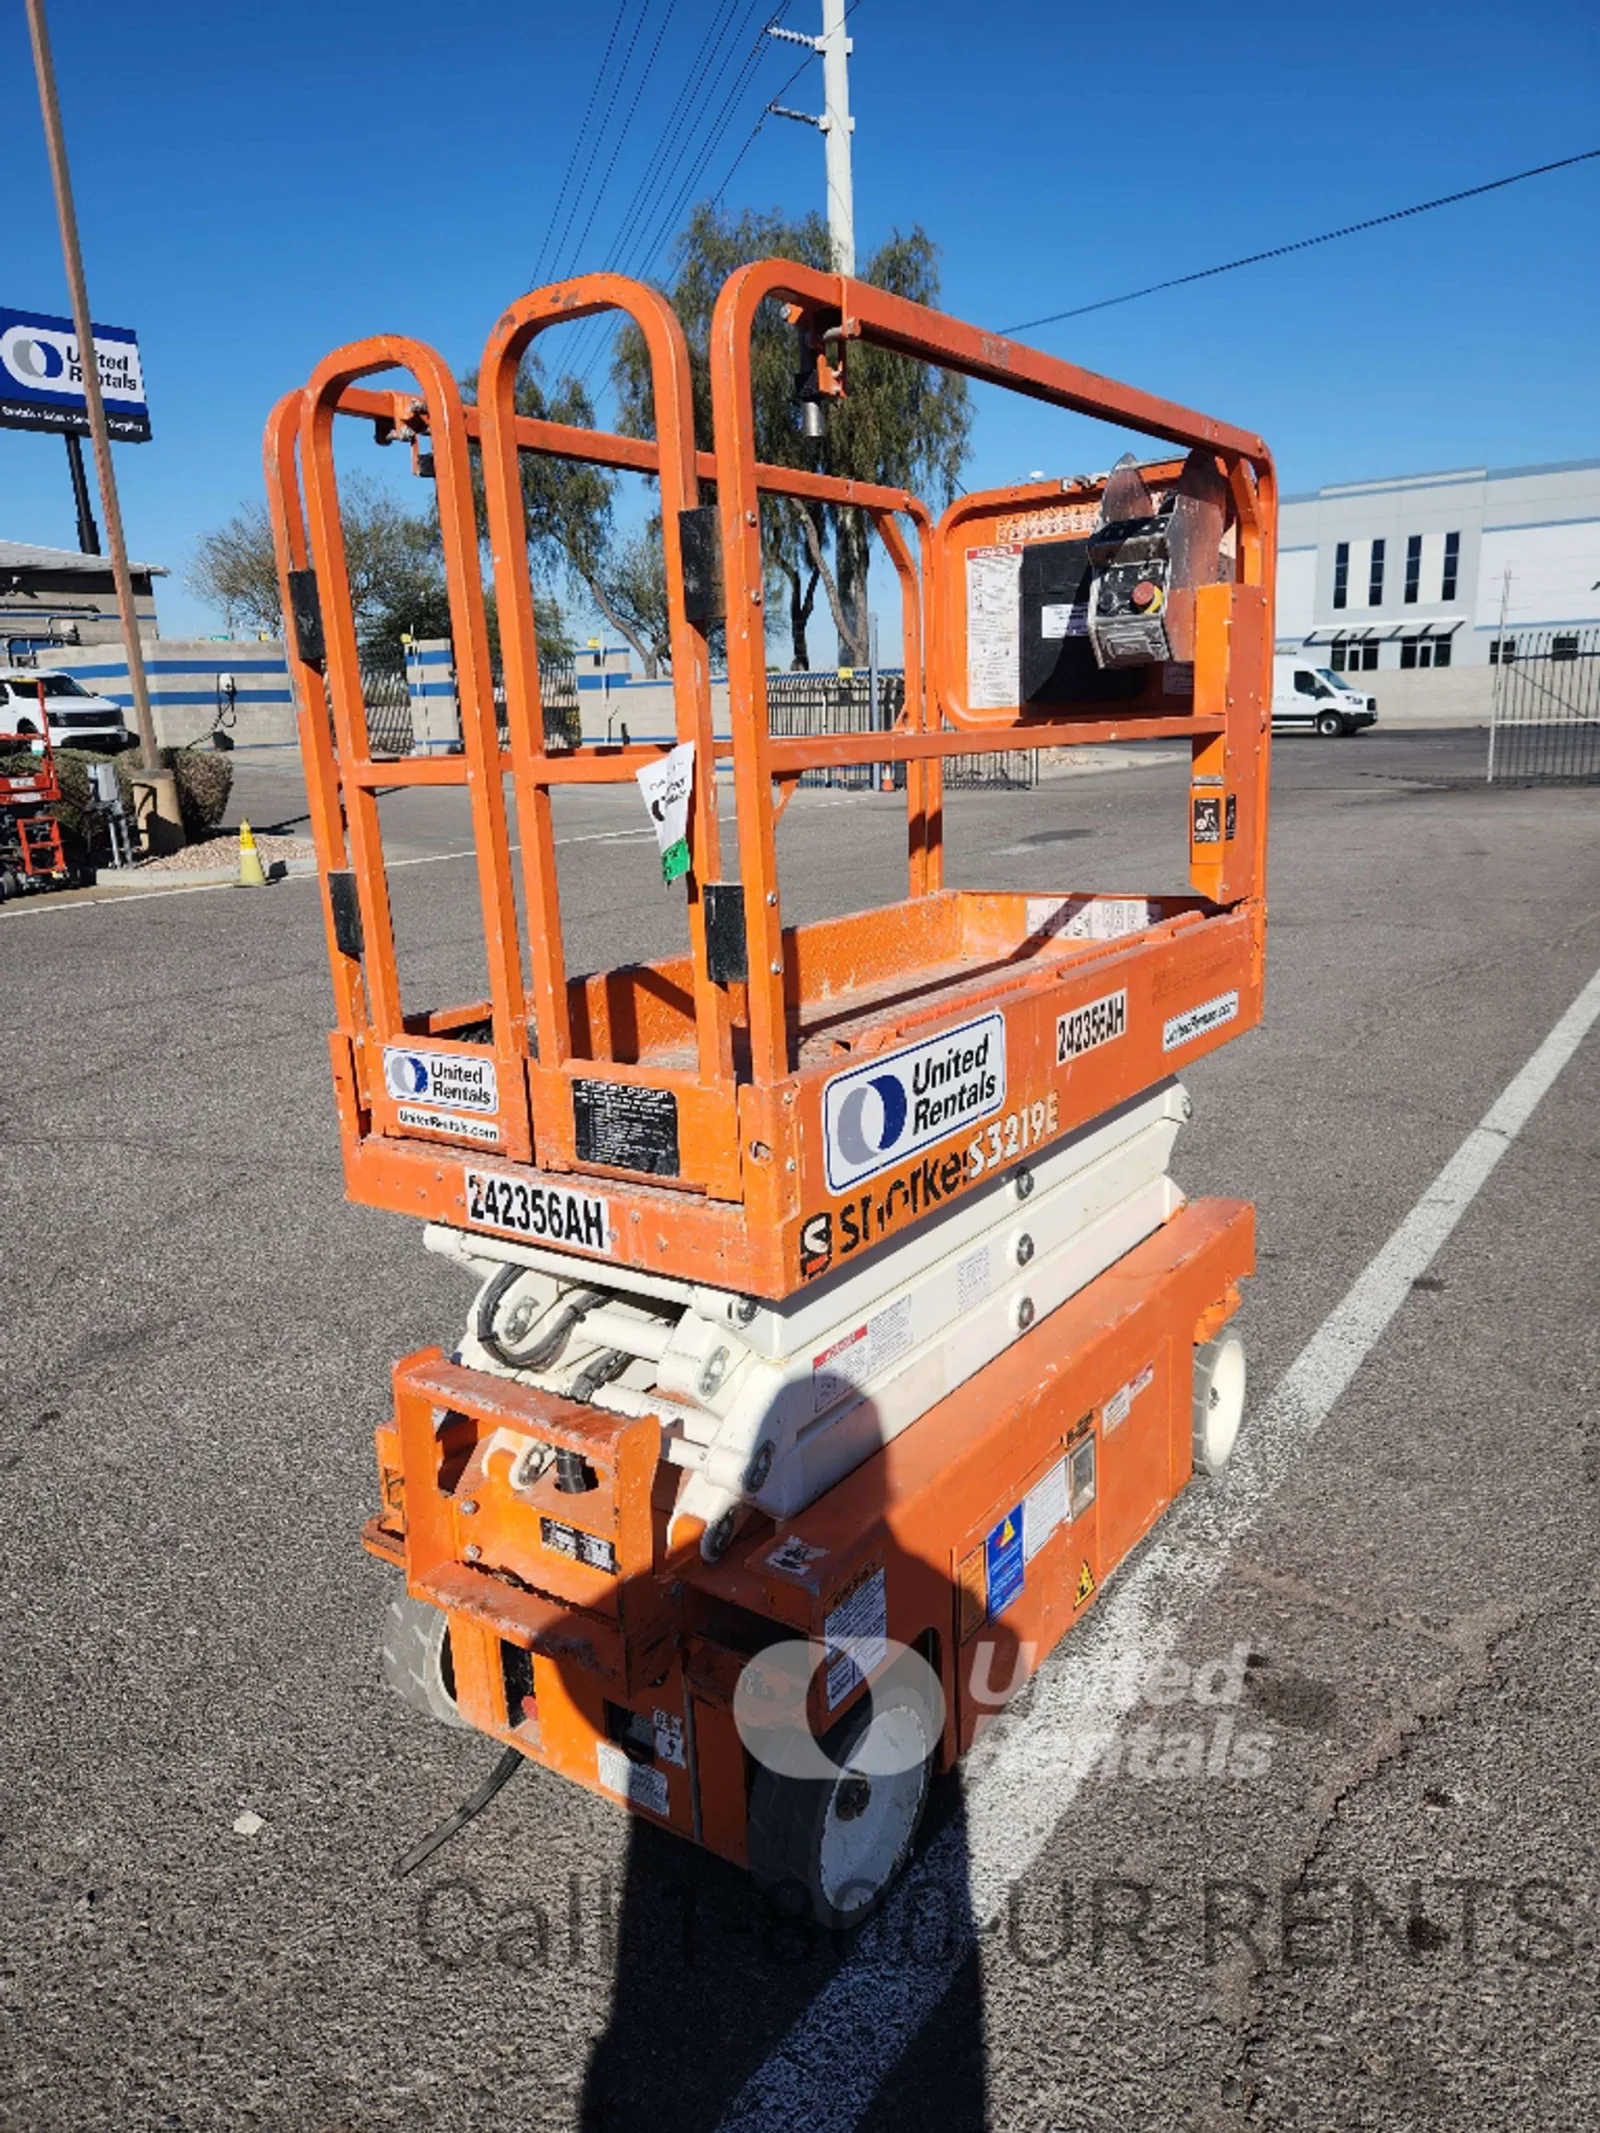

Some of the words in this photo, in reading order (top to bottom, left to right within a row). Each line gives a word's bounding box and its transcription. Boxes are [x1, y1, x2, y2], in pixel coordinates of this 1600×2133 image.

[67, 346, 128, 371] Uted
[69, 366, 137, 390] Rtals
[431, 1061, 482, 1084] United
[913, 1033, 988, 1096] United
[433, 1081, 491, 1105] Rentals
[913, 1070, 996, 1136] Rentals
[967, 1090, 1059, 1181] S3219E
[468, 1174, 604, 1249] 242356AH
